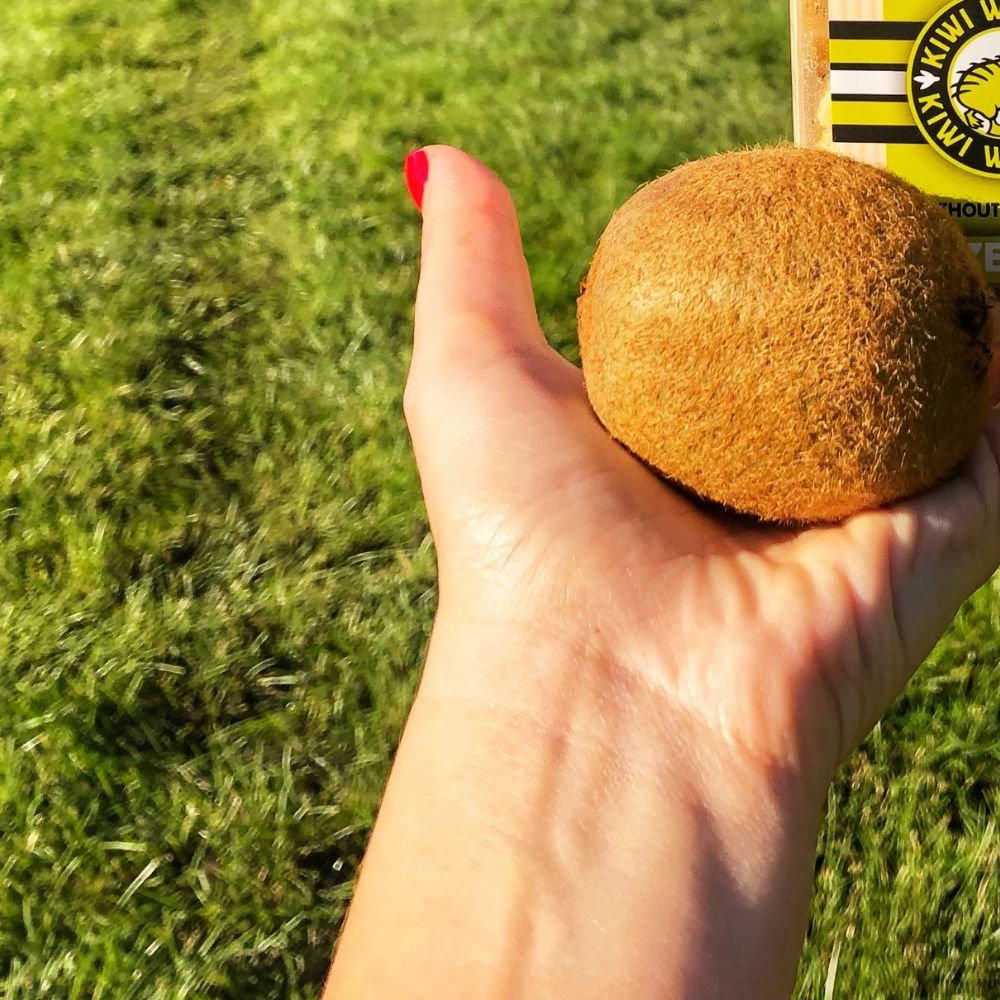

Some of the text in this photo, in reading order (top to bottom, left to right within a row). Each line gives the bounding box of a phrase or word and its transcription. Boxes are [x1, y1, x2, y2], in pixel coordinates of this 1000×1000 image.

[921, 8, 975, 69] KIWI
[918, 92, 973, 157] KIWI
[939, 202, 1000, 217] HOUT
